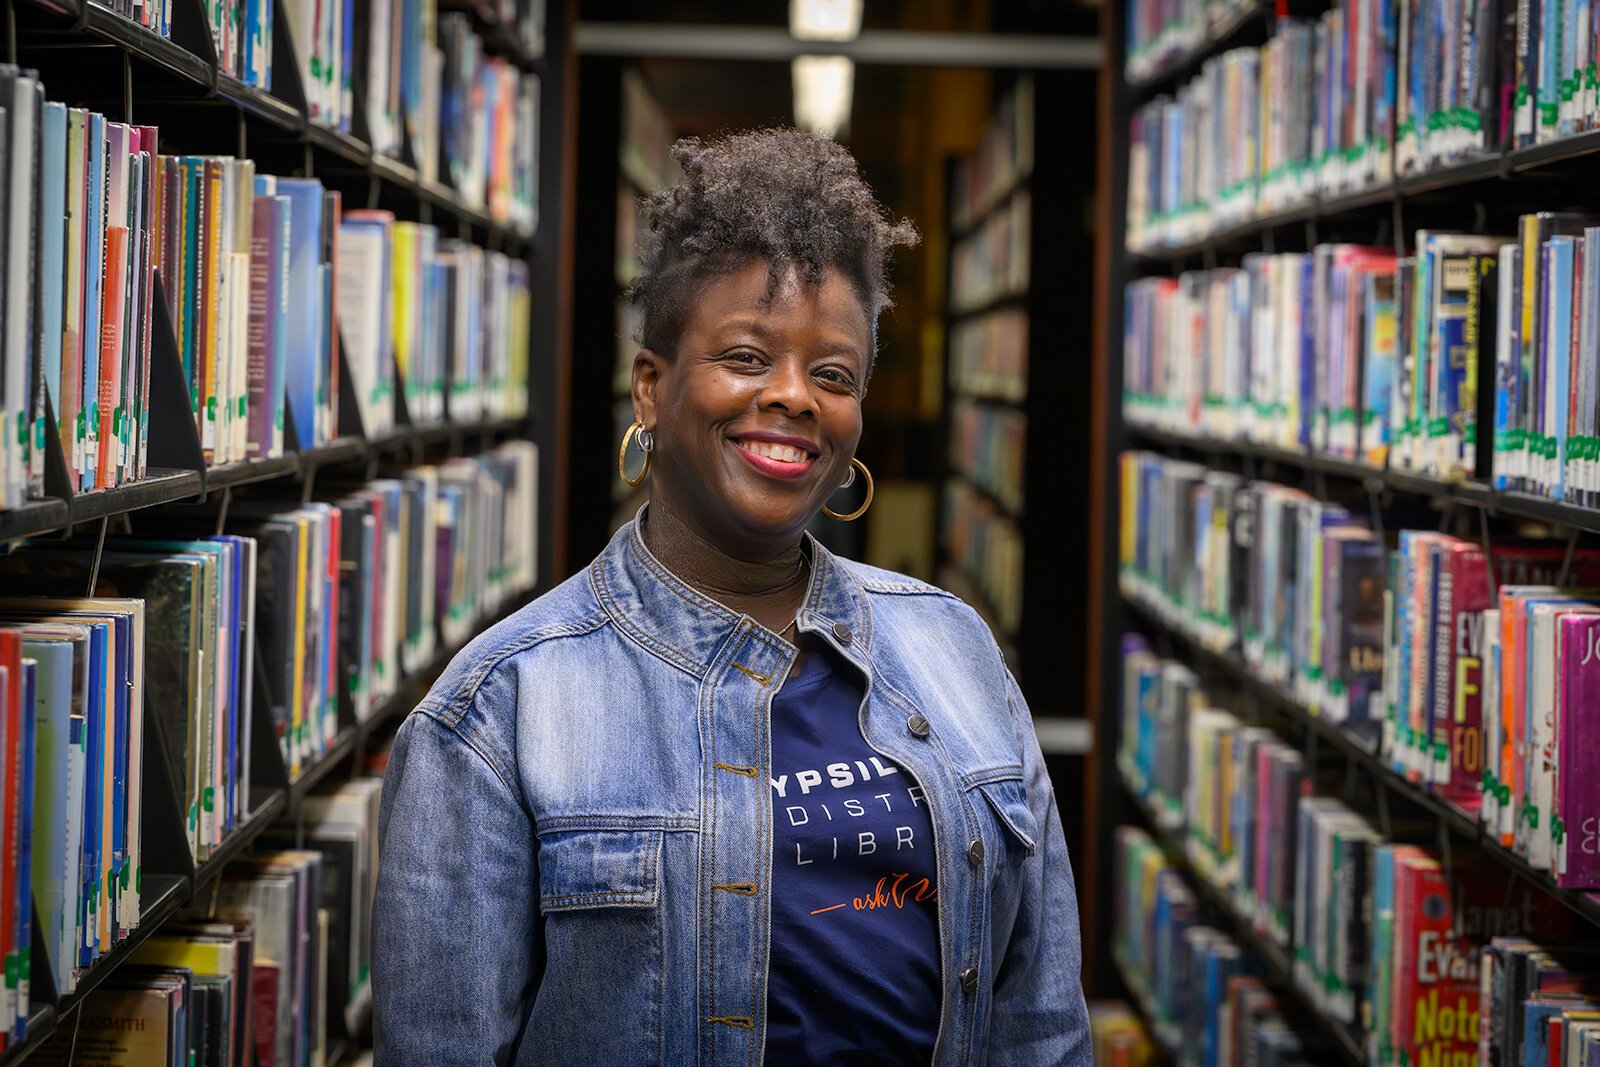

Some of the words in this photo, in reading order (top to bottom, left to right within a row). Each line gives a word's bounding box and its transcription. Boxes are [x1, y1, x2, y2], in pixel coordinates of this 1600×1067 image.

[1581, 626, 1600, 666] J
[1581, 816, 1600, 836] C
[796, 825, 915, 866] LIBR
[1580, 835, 1600, 855] C
